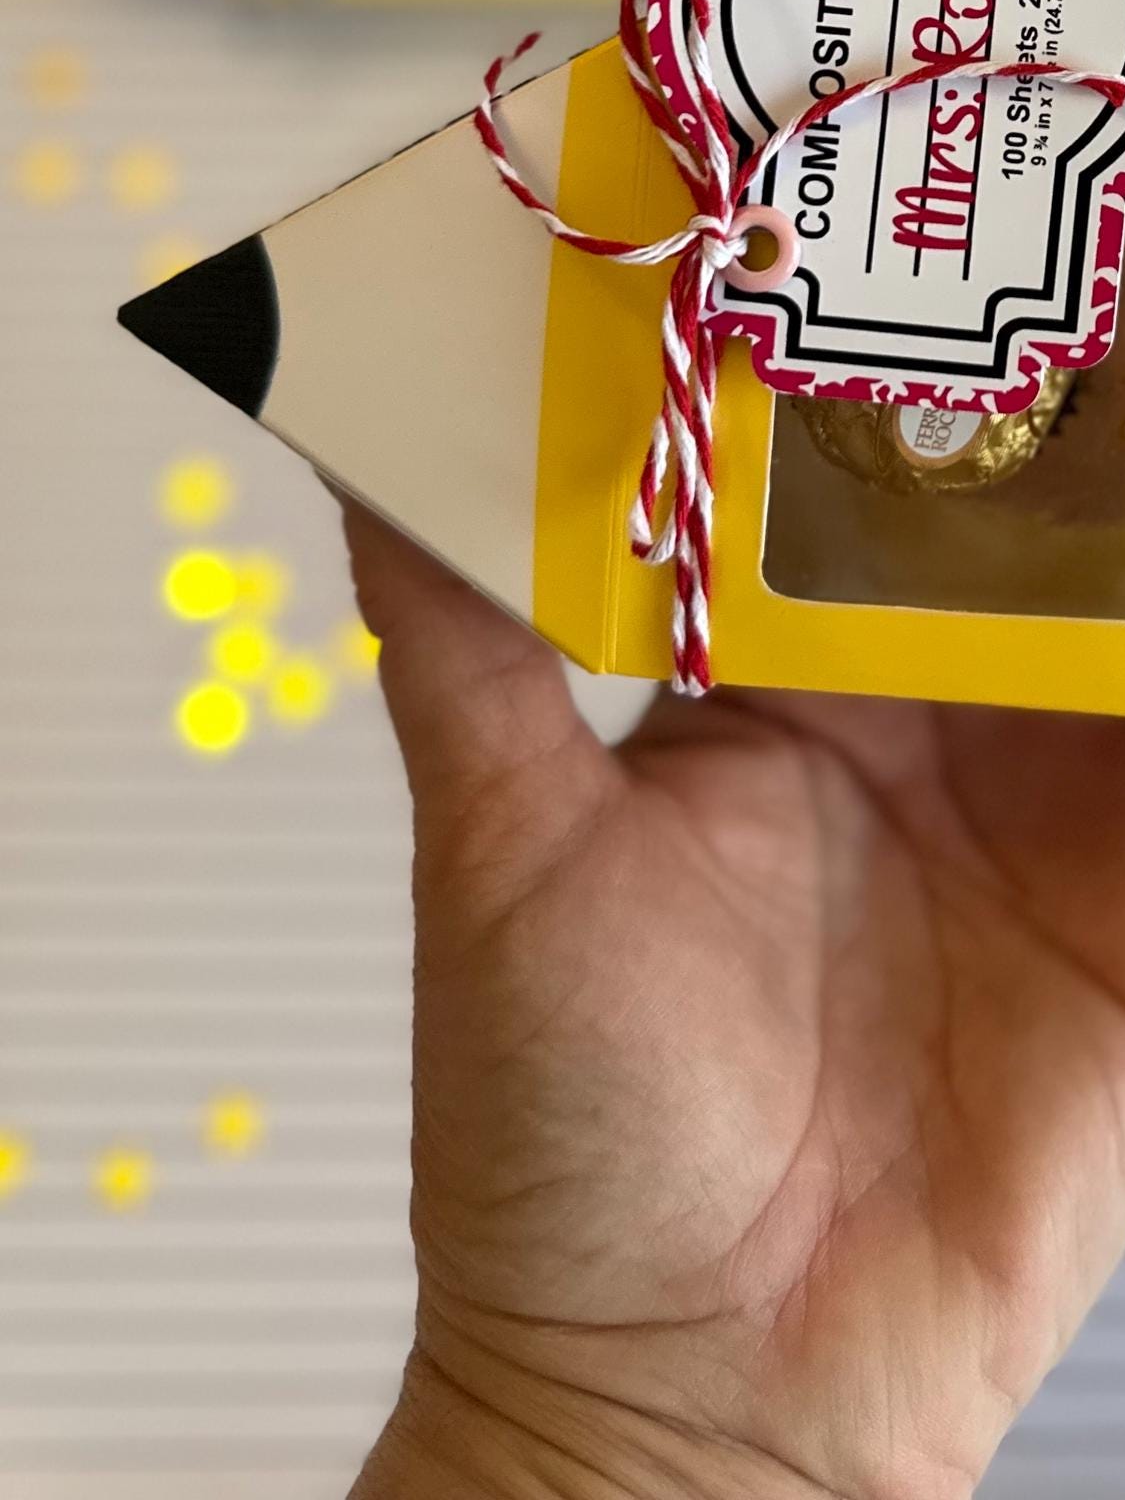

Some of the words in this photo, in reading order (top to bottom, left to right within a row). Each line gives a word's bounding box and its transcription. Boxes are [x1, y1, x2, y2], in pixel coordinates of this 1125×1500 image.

[1042, 40, 1058, 56] in
[1038, 81, 1054, 92] 7
[1040, 97, 1053, 108] x
[1034, 112, 1051, 129] in
[1001, 131, 1028, 181] 100
[1030, 155, 1047, 166] 9
[914, 407, 939, 449] FERR
[931, 410, 958, 453] ROC
